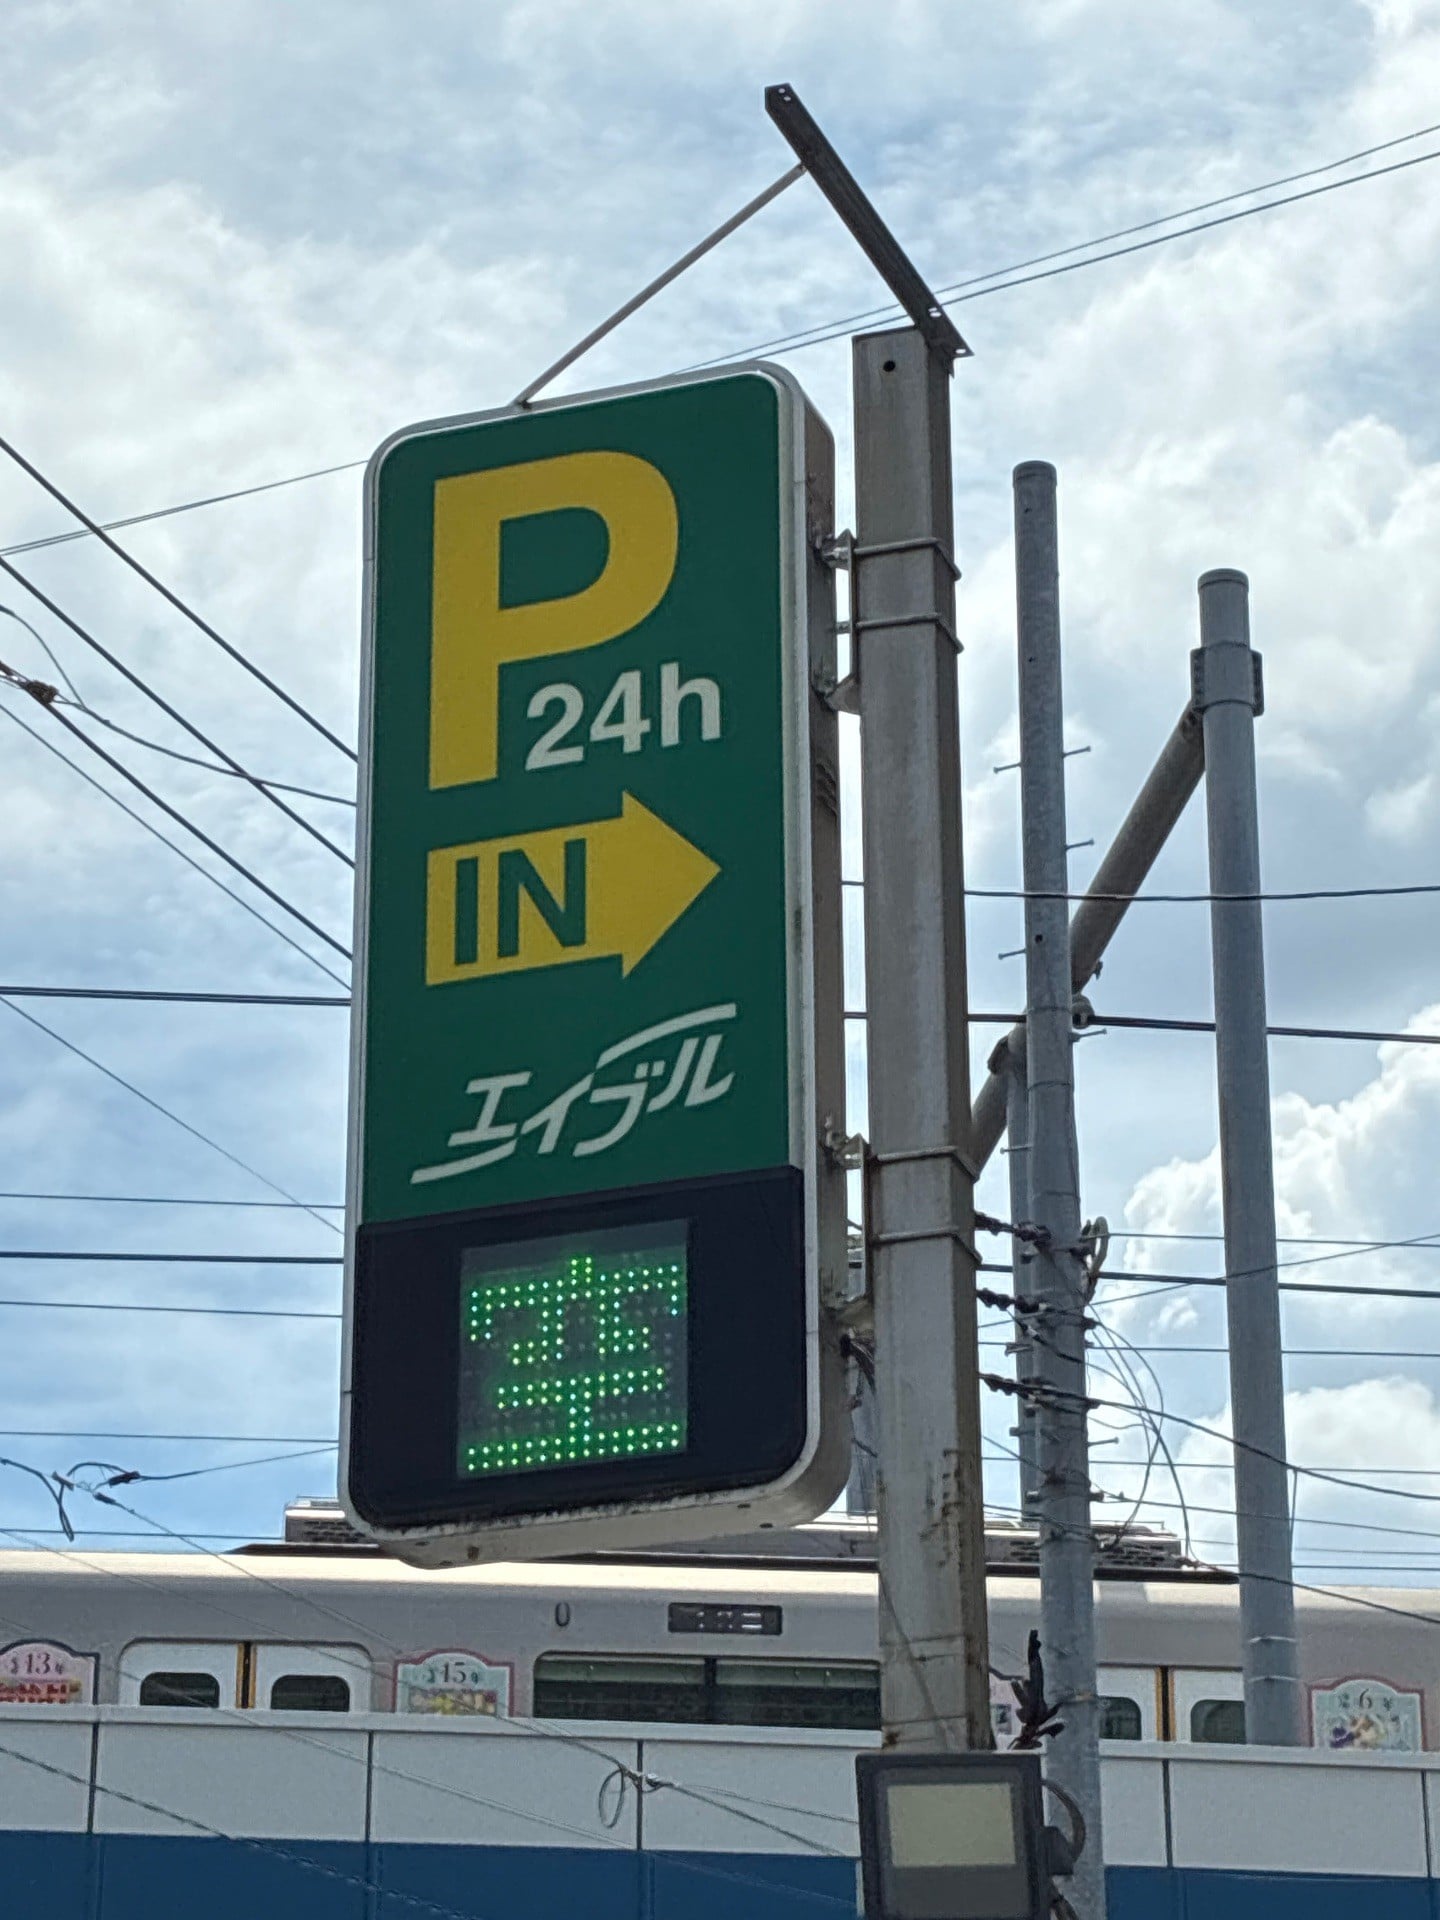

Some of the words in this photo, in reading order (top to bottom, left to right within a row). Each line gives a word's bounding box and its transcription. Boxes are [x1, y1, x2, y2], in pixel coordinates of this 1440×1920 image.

[429, 451, 679, 791] P
[525, 662, 721, 771] 24h
[454, 837, 587, 965] IN
[447, 1034, 736, 1158] エイブル
[467, 1255, 679, 1472] 空
